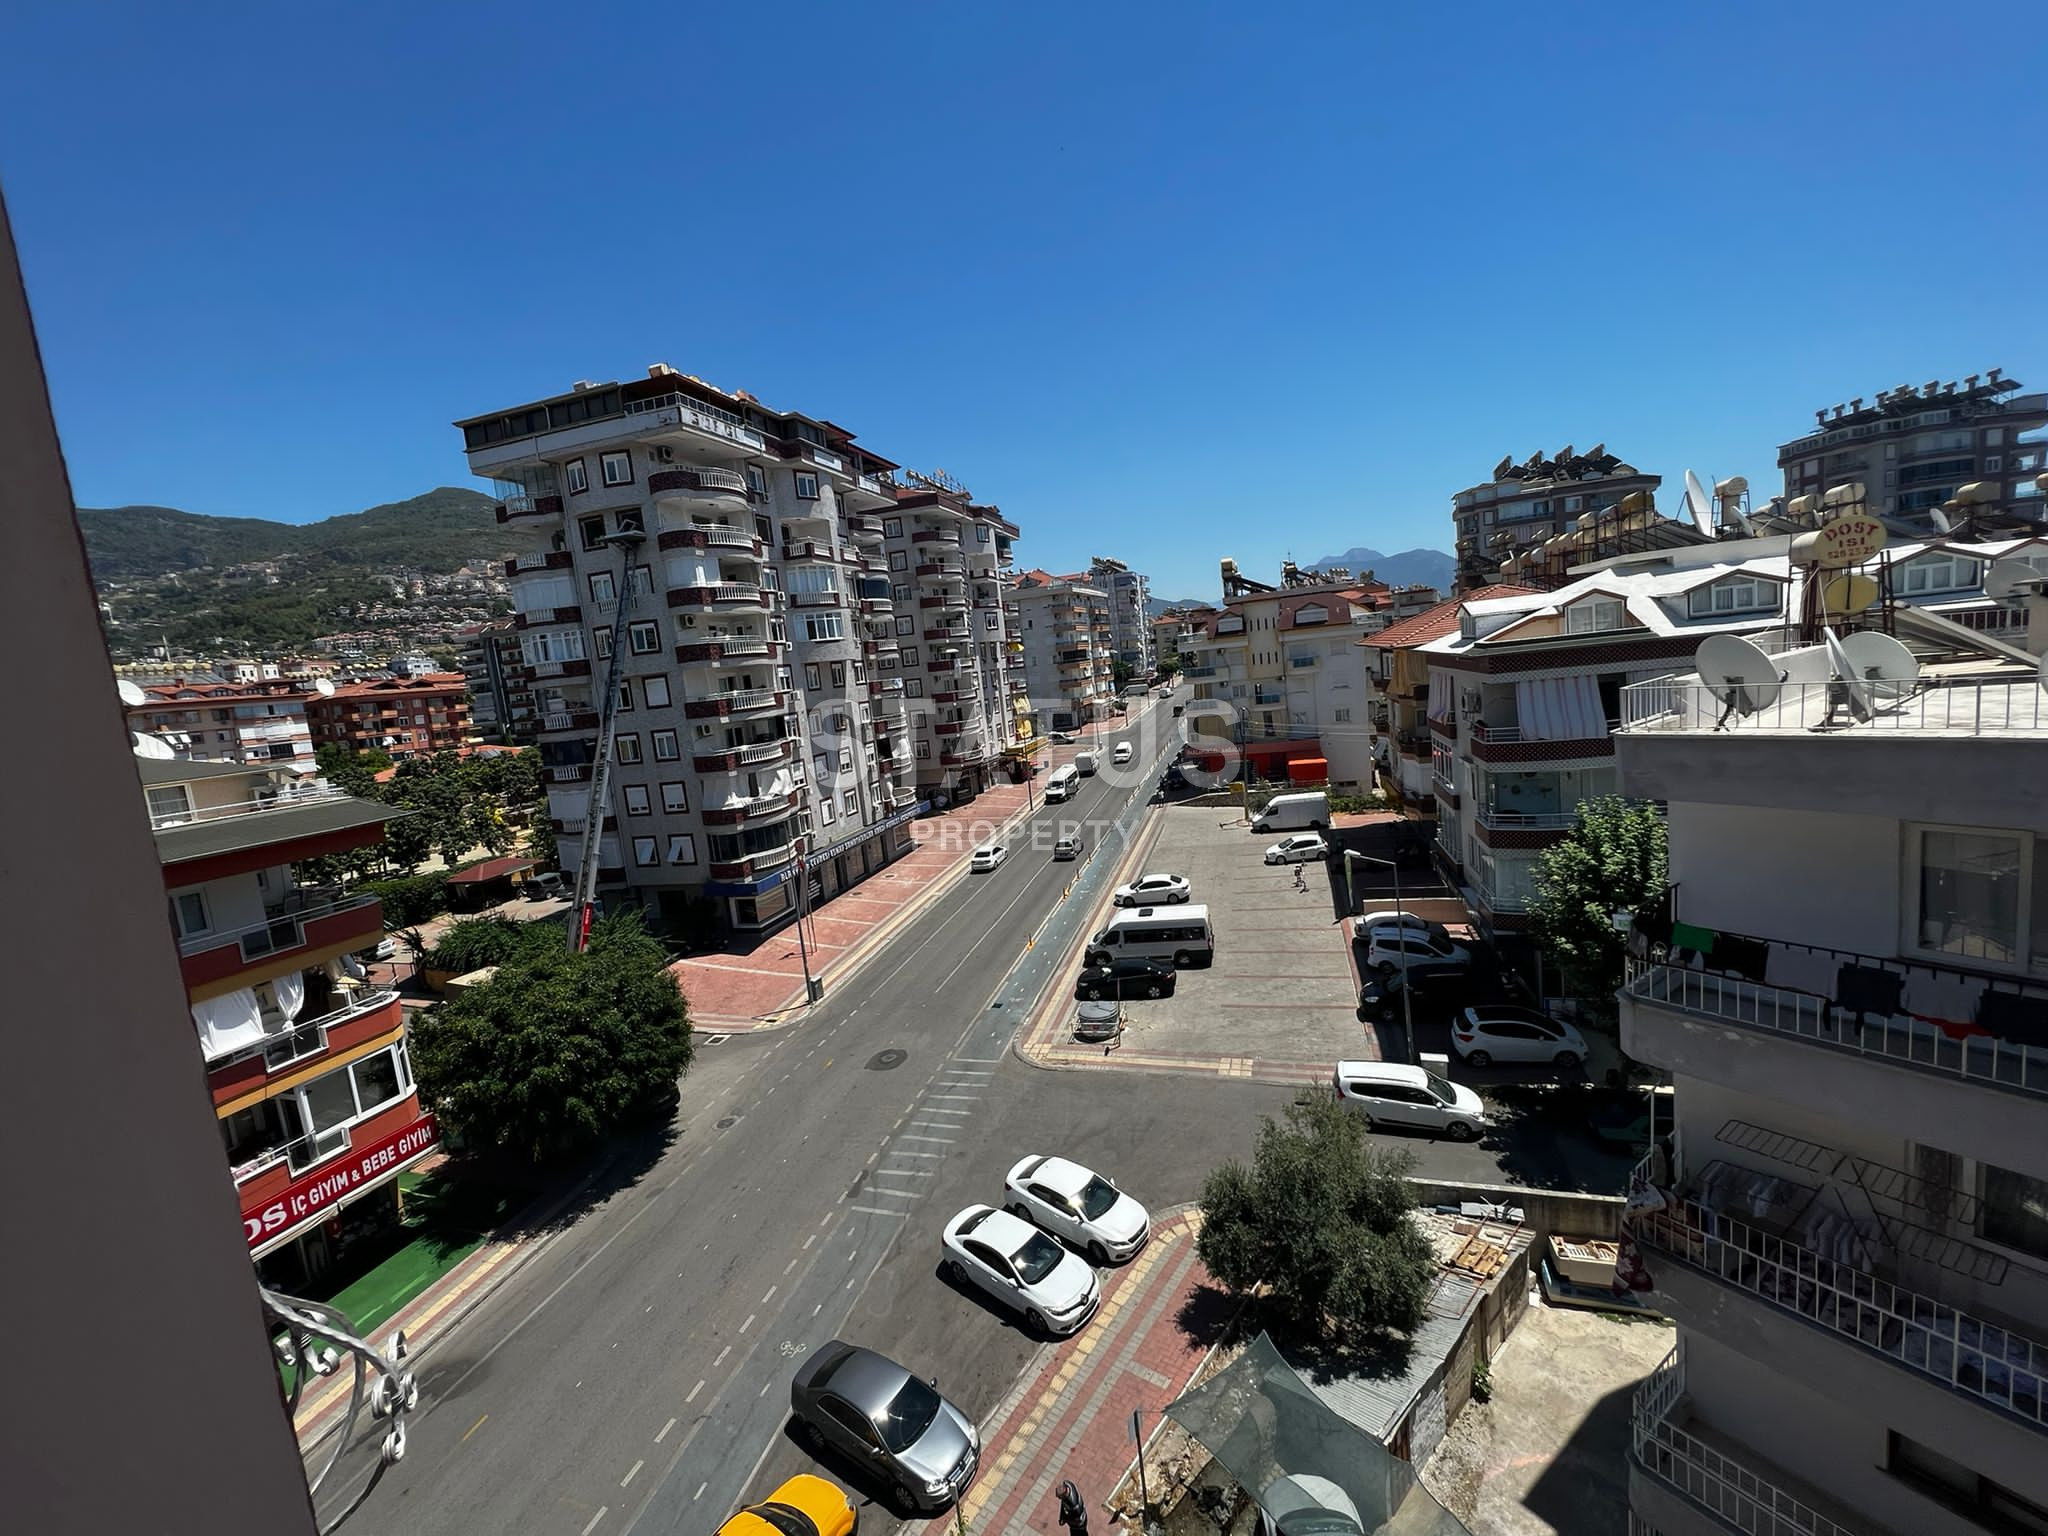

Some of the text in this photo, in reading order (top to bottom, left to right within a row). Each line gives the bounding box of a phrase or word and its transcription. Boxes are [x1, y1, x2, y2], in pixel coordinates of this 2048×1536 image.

[1823, 521, 1879, 541] DOST
[291, 1195, 308, 1216] İÇ
[309, 1171, 350, 1205] GİYİM
[352, 1168, 361, 1182] &
[362, 1145, 397, 1176] BEBE
[398, 1125, 433, 1154] GİYİM
